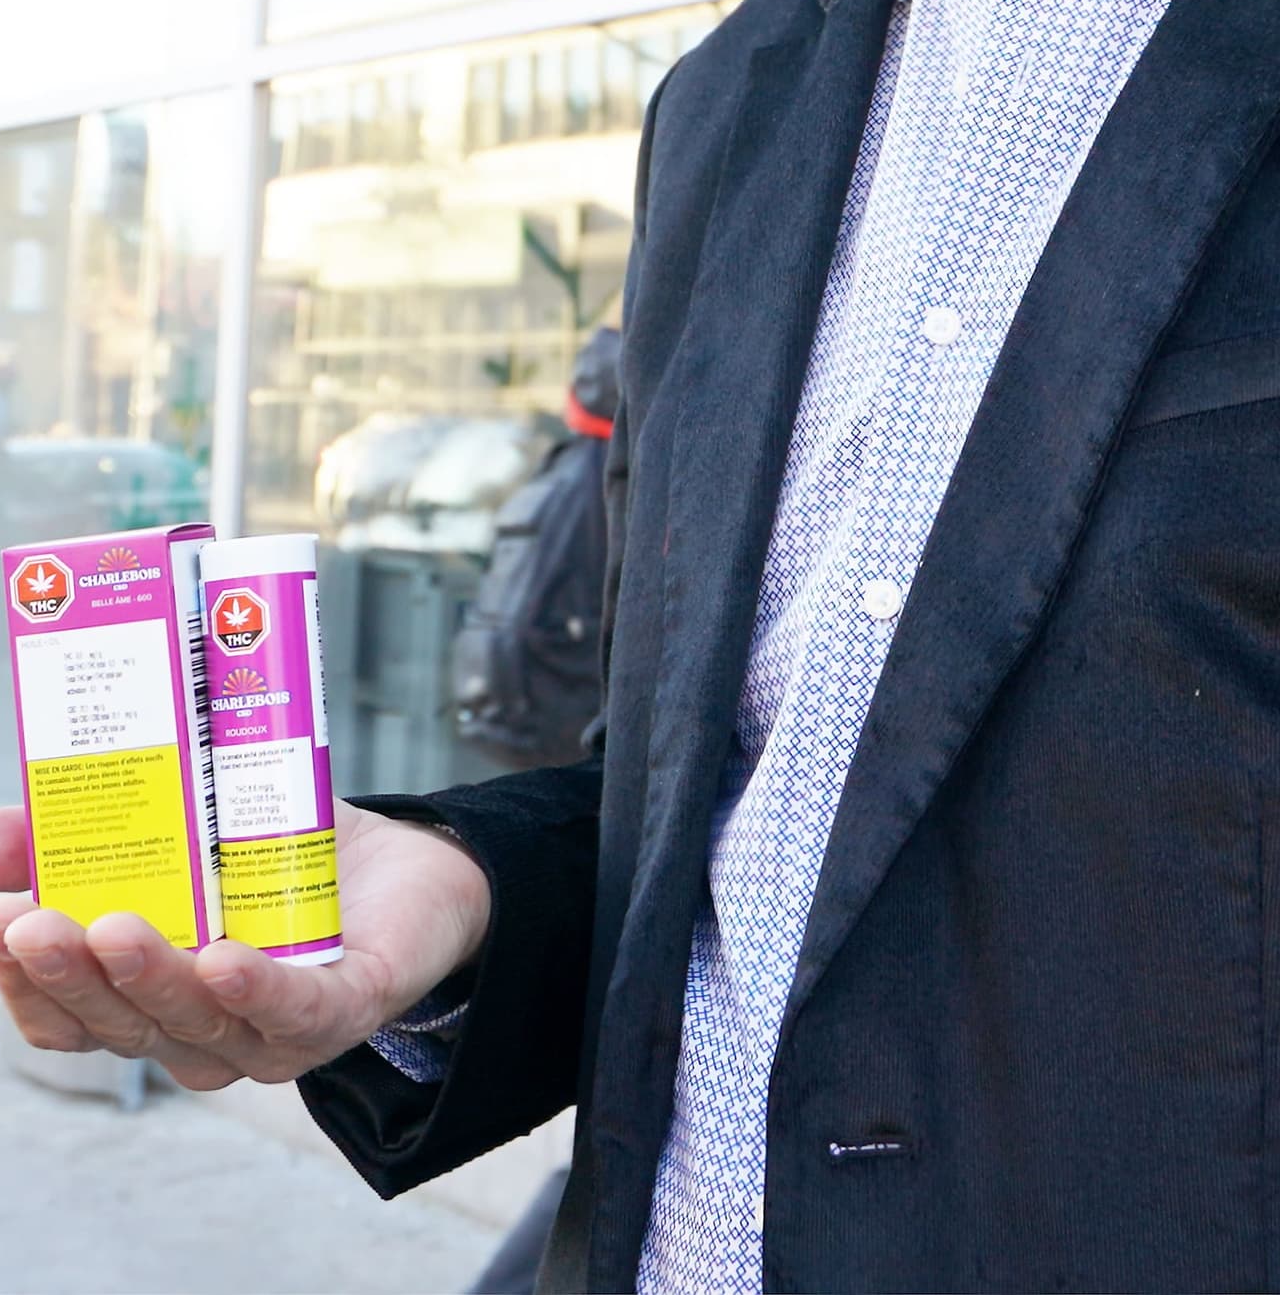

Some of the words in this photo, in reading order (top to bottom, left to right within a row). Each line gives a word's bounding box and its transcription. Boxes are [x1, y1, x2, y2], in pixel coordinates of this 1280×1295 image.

[79, 567, 161, 588] CHARLEBOIS
[29, 599, 57, 614] THC
[91, 599, 113, 608] BELLE
[115, 594, 131, 604] ÂME
[226, 633, 252, 647] THC
[211, 691, 291, 711] CHARLEBOIS
[226, 725, 267, 737] ROUDOUX
